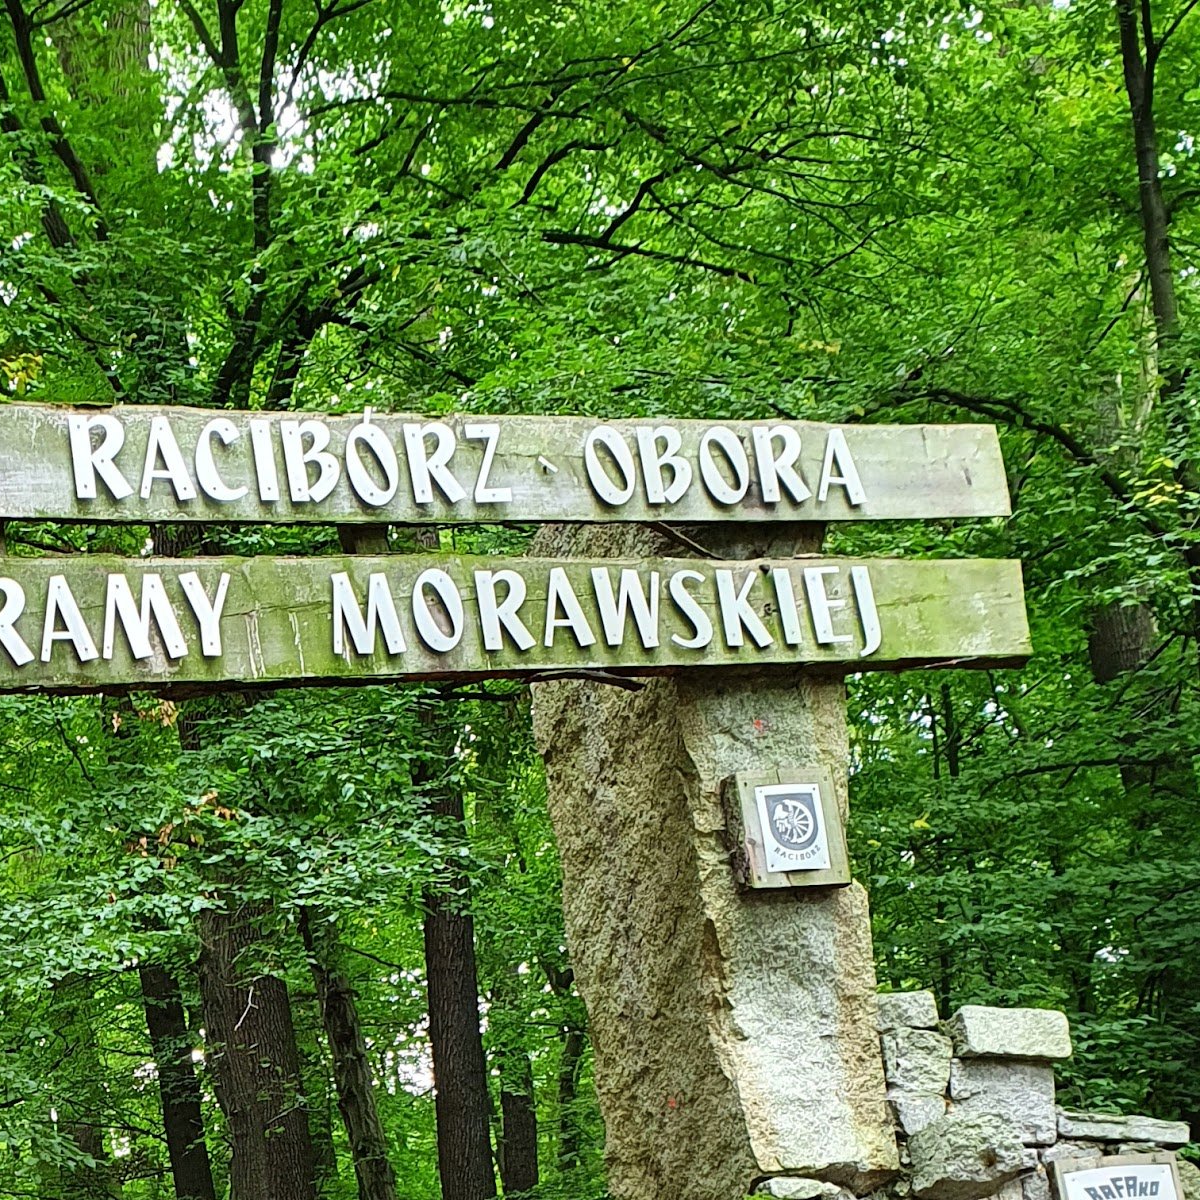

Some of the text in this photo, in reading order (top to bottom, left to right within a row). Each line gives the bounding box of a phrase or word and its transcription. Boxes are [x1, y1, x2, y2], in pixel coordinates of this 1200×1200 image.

[68, 406, 512, 506] RACIBÓRZ
[584, 425, 869, 506] OBORA
[330, 566, 883, 658] MORAWSKIEJ
[1084, 1176, 1160, 1200] RAFAKO
